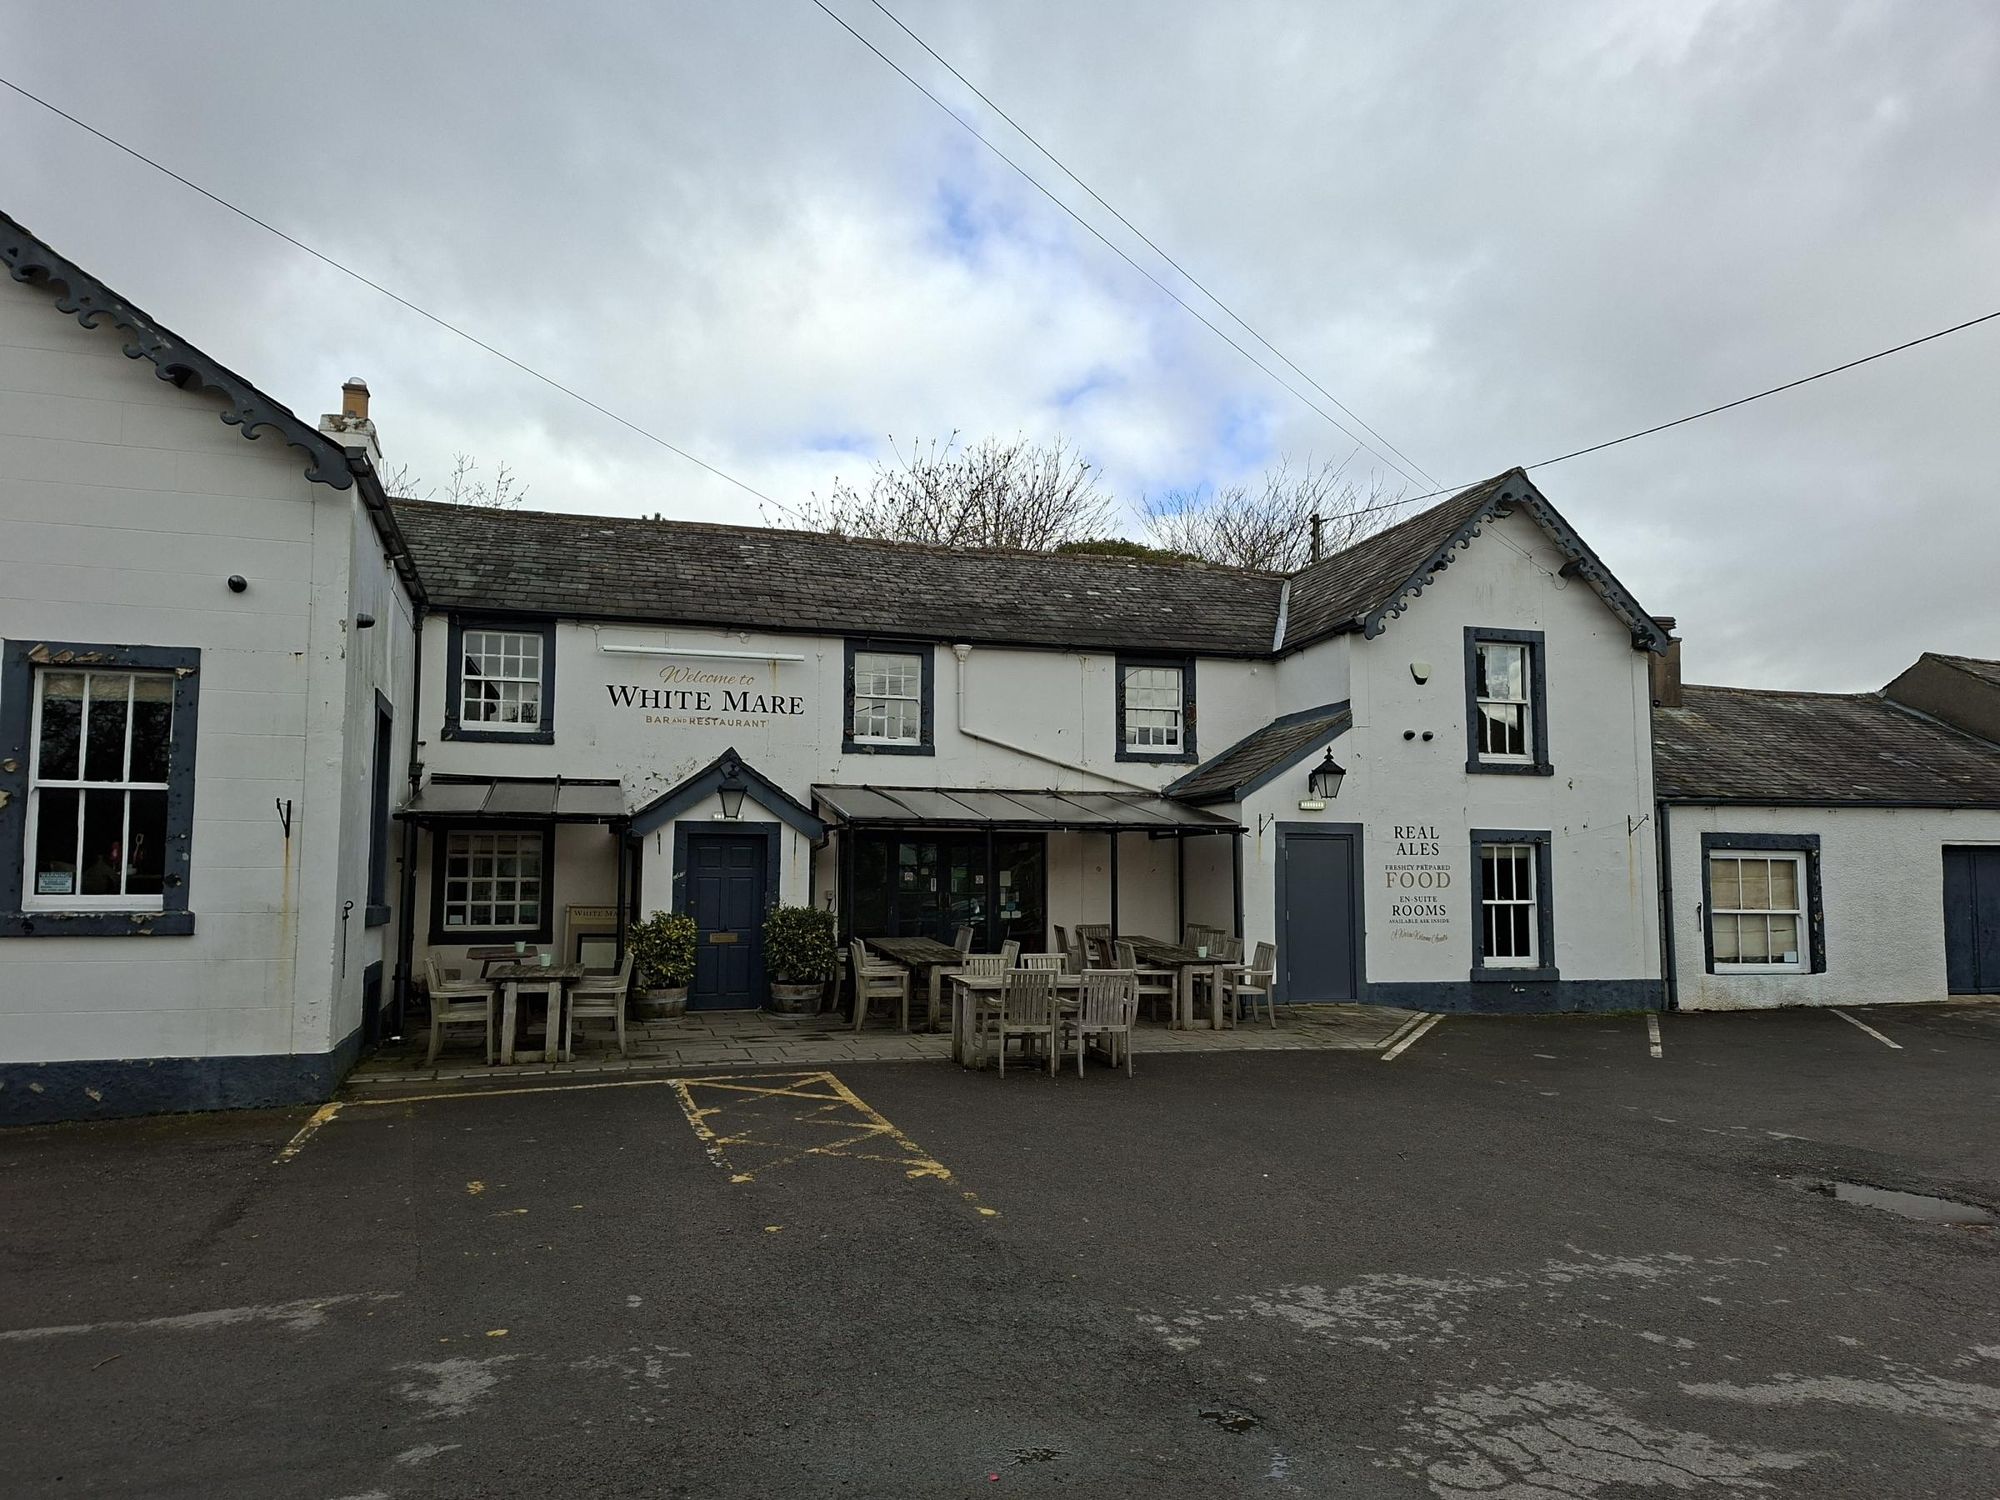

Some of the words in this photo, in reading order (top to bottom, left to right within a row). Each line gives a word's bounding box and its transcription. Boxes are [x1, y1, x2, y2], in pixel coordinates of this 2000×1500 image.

[659, 665, 735, 685] Welcome
[739, 674, 755, 686] to
[605, 684, 712, 710] WHITE
[721, 690, 805, 715] MARE
[645, 715, 670, 724] BAR
[689, 717, 767, 728] RESTAURANT
[1394, 826, 1440, 839] REAL
[1396, 842, 1440, 856] ALES
[1385, 871, 1451, 888] FOOD
[1392, 904, 1447, 916] ROOMS
